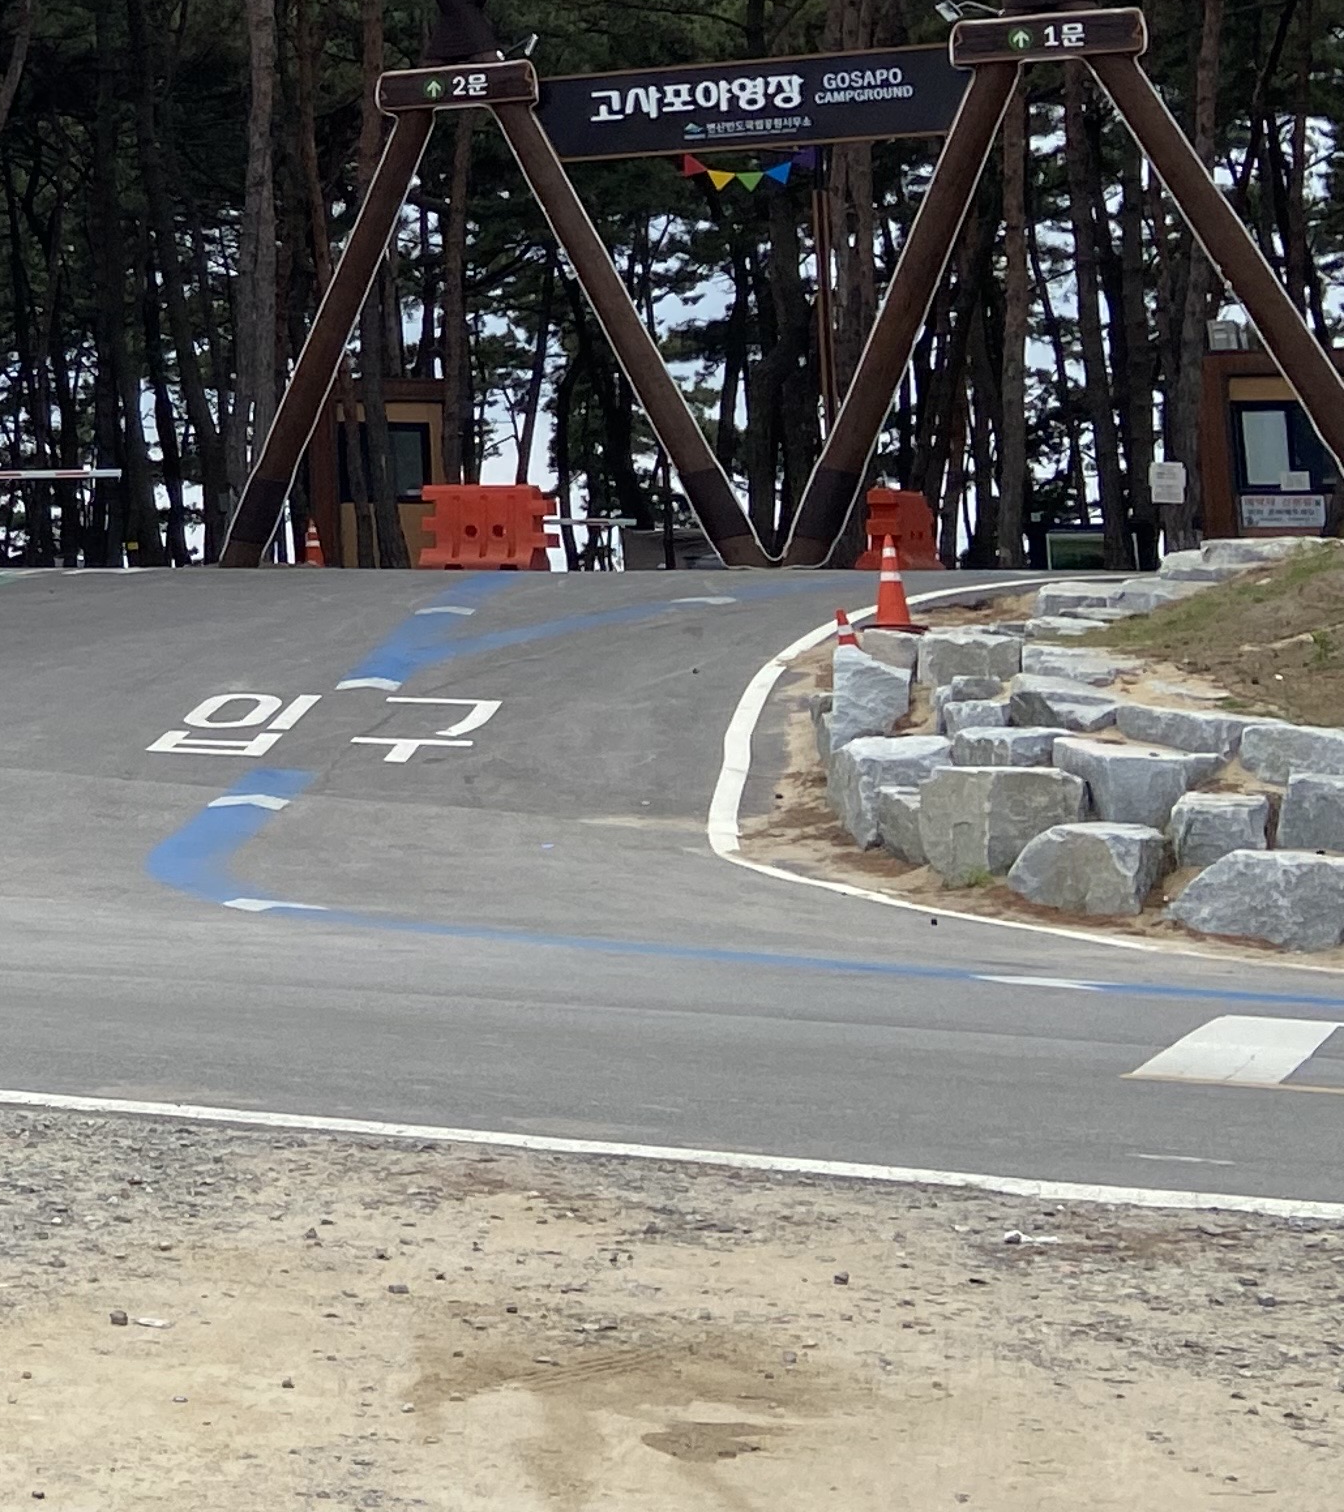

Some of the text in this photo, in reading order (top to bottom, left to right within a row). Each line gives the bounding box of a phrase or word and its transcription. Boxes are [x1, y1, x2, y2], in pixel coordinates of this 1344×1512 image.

[1043, 22, 1086, 48] 1문
[452, 73, 489, 96] 2문
[822, 67, 903, 89] GOSAPO
[590, 74, 805, 122] 고사포야영장
[814, 85, 914, 104] CAMPGROUND
[145, 693, 504, 763] 입구
